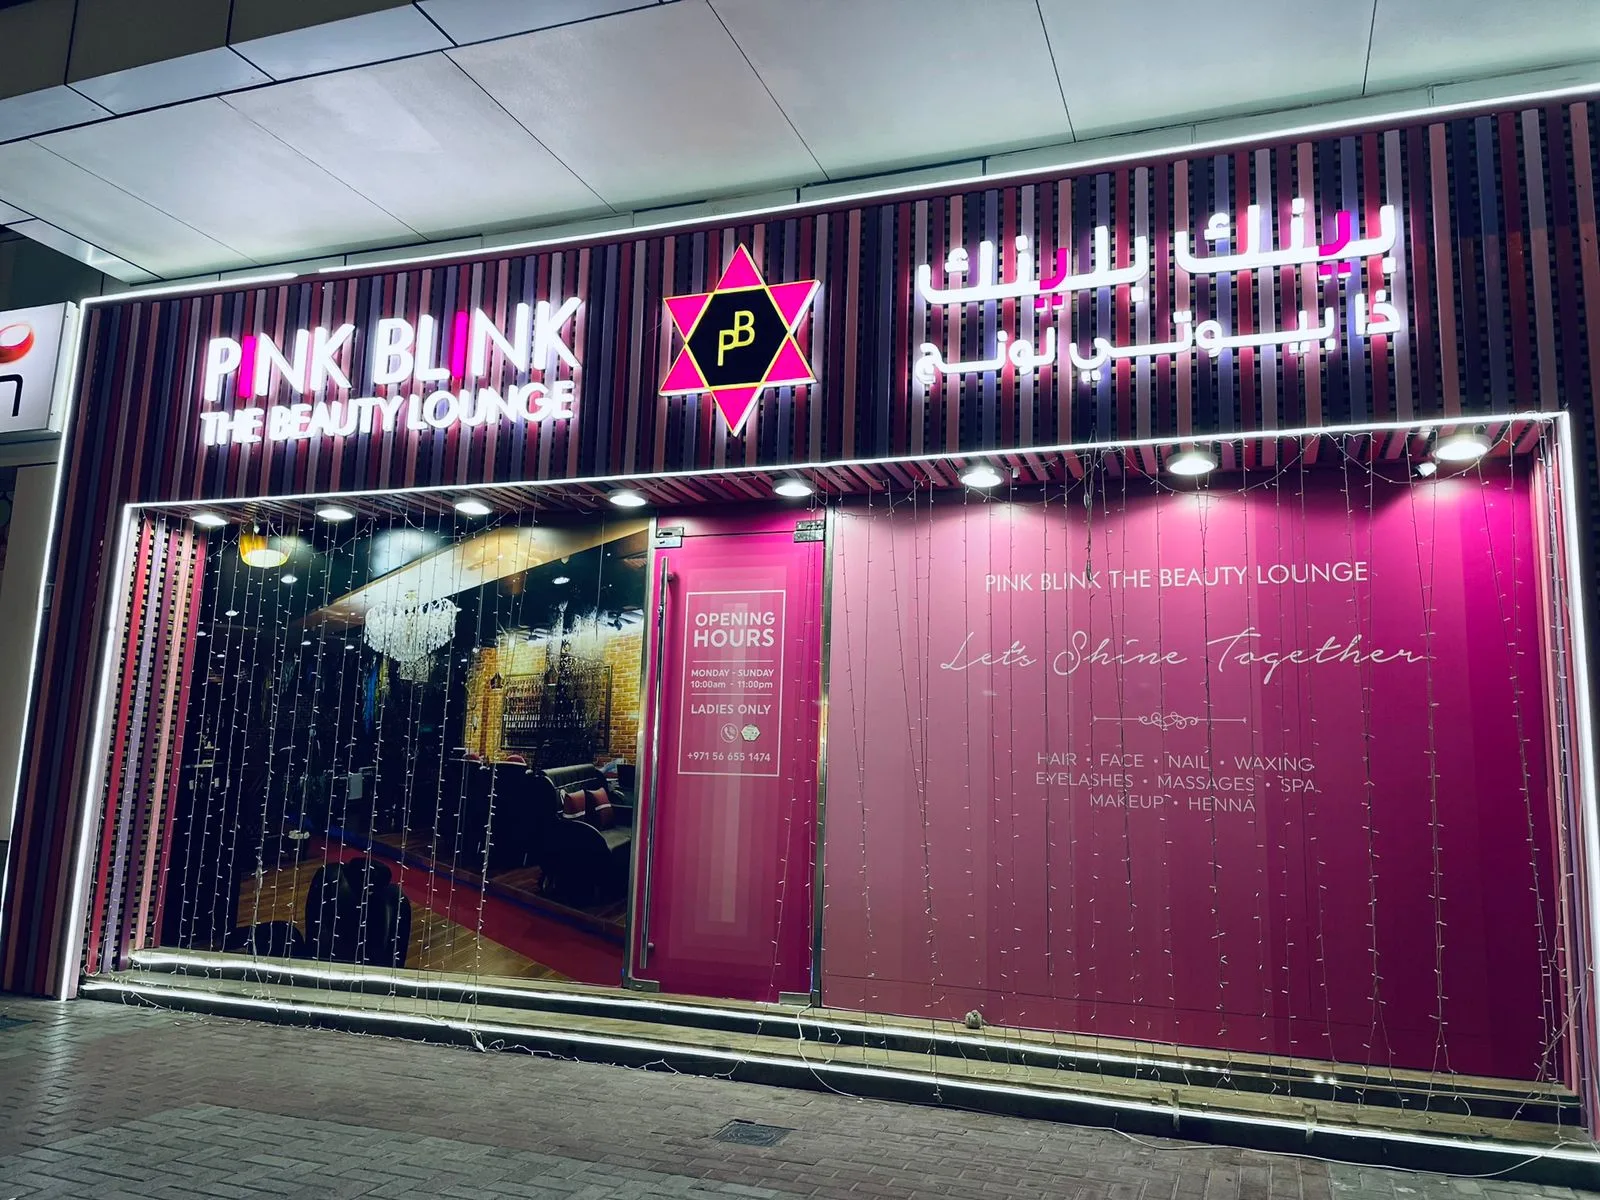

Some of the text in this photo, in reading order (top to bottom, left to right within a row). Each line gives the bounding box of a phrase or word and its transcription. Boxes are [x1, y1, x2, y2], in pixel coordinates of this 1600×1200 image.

[204, 296, 583, 402] PINK BLINK
[200, 380, 575, 446] THE BEAUTY LOUNGE
[985, 561, 1368, 592] PINK BLINK THE BEAUTY LOUNGE
[695, 611, 775, 627] OPENING
[693, 628, 775, 648] HOURS
[1053, 630, 1187, 675] Shine
[1205, 626, 1425, 684] Together
[691, 669, 730, 677] MONDAY
[738, 669, 774, 677] SUNDAY
[691, 681, 726, 689] 10:00am
[737, 681, 773, 690] 11:00pm
[691, 704, 772, 715] LADIES ONLY
[687, 751, 771, 762] +971 56 655 1474
[1037, 752, 1314, 772] HAIR FACE NAIL WAXING
[1036, 771, 1316, 793] EYELASHES MASSAGES SPA
[1090, 794, 1256, 812] MAKEUP HENNA
